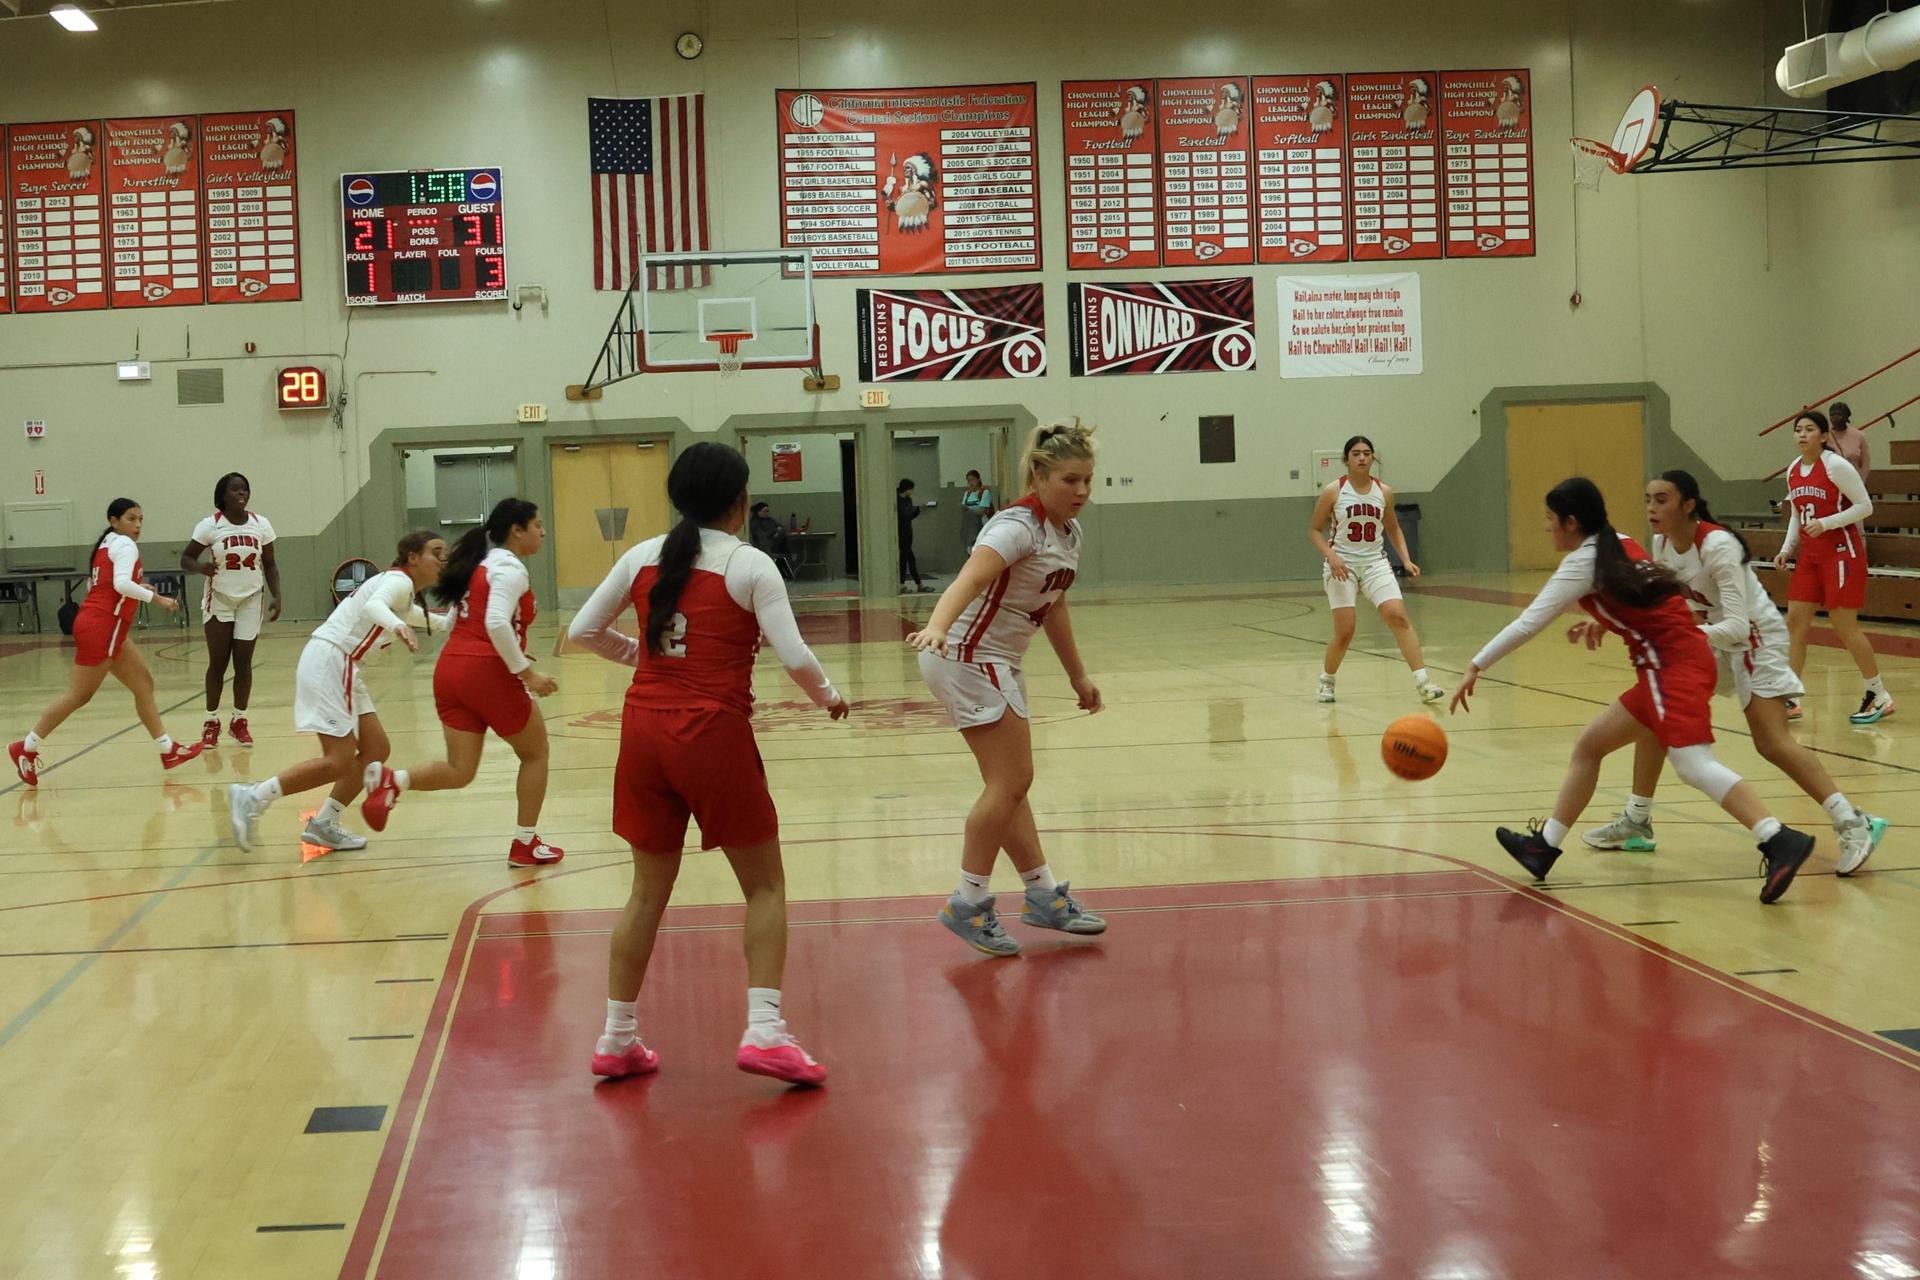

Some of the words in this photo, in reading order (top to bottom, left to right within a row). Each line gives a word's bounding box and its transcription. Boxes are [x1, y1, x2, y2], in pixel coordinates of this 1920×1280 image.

[1256, 96, 1278, 104] HIGH
[1351, 93, 1372, 101] HIGH
[1444, 91, 1465, 99] HIGH
[1456, 100, 1486, 108] LEAGUE
[205, 134, 230, 142] HIGH
[972, 129, 1024, 137] VOLLEYBALL
[1273, 133, 1319, 145] Softball
[1380, 130, 1434, 140] Basketball
[1474, 128, 1528, 139] Basketball
[13, 143, 37, 151] HIGH
[110, 139, 134, 147] HIGH
[218, 143, 249, 151] LEAGUE
[1178, 136, 1226, 146] Baseball
[25, 152, 56, 160] LEAGUE
[122, 148, 152, 156] LEAGUE
[1262, 151, 1280, 159] 1991
[51, 180, 89, 192] Soccer
[411, 173, 465, 204] 1:58
[353, 208, 384, 218] HOME
[407, 208, 438, 216] PERIOD
[458, 203, 495, 214] GUEST
[242, 218, 260, 226] 2011
[354, 219, 393, 250] 21
[463, 215, 502, 246] 31
[117, 238, 135, 246] 1975
[347, 253, 374, 261] FOULS
[438, 249, 460, 257] FOUL
[476, 247, 502, 255] FOULS
[485, 257, 504, 286] 3
[397, 294, 425, 302] MATCH
[1344, 290, 1357, 303] long
[1359, 291, 1371, 303] may
[1385, 288, 1401, 302] reign
[1293, 309, 1305, 320] Hail
[1307, 310, 1313, 320] to
[1315, 308, 1324, 319] her
[1368, 308, 1381, 318] true
[1382, 306, 1403, 317] remain
[891, 303, 986, 366] FOCUS
[1088, 297, 1099, 361] REDSKINS
[1101, 297, 1196, 360] ONWARD
[1292, 324, 1300, 335] So
[1302, 326, 1310, 334] we
[1357, 322, 1366, 333] her
[1392, 322, 1405, 335] long
[877, 303, 888, 367] REDSKINS
[1288, 340, 1302, 355] Hail
[1304, 342, 1311, 354] to
[282, 372, 319, 402] 28
[867, 392, 884, 404] EXIT
[524, 406, 541, 419] EXIT
[1345, 504, 1382, 520] TRIBE
[1347, 522, 1376, 543] 30
[222, 535, 259, 550] TRIBE
[226, 552, 257, 571] 24
